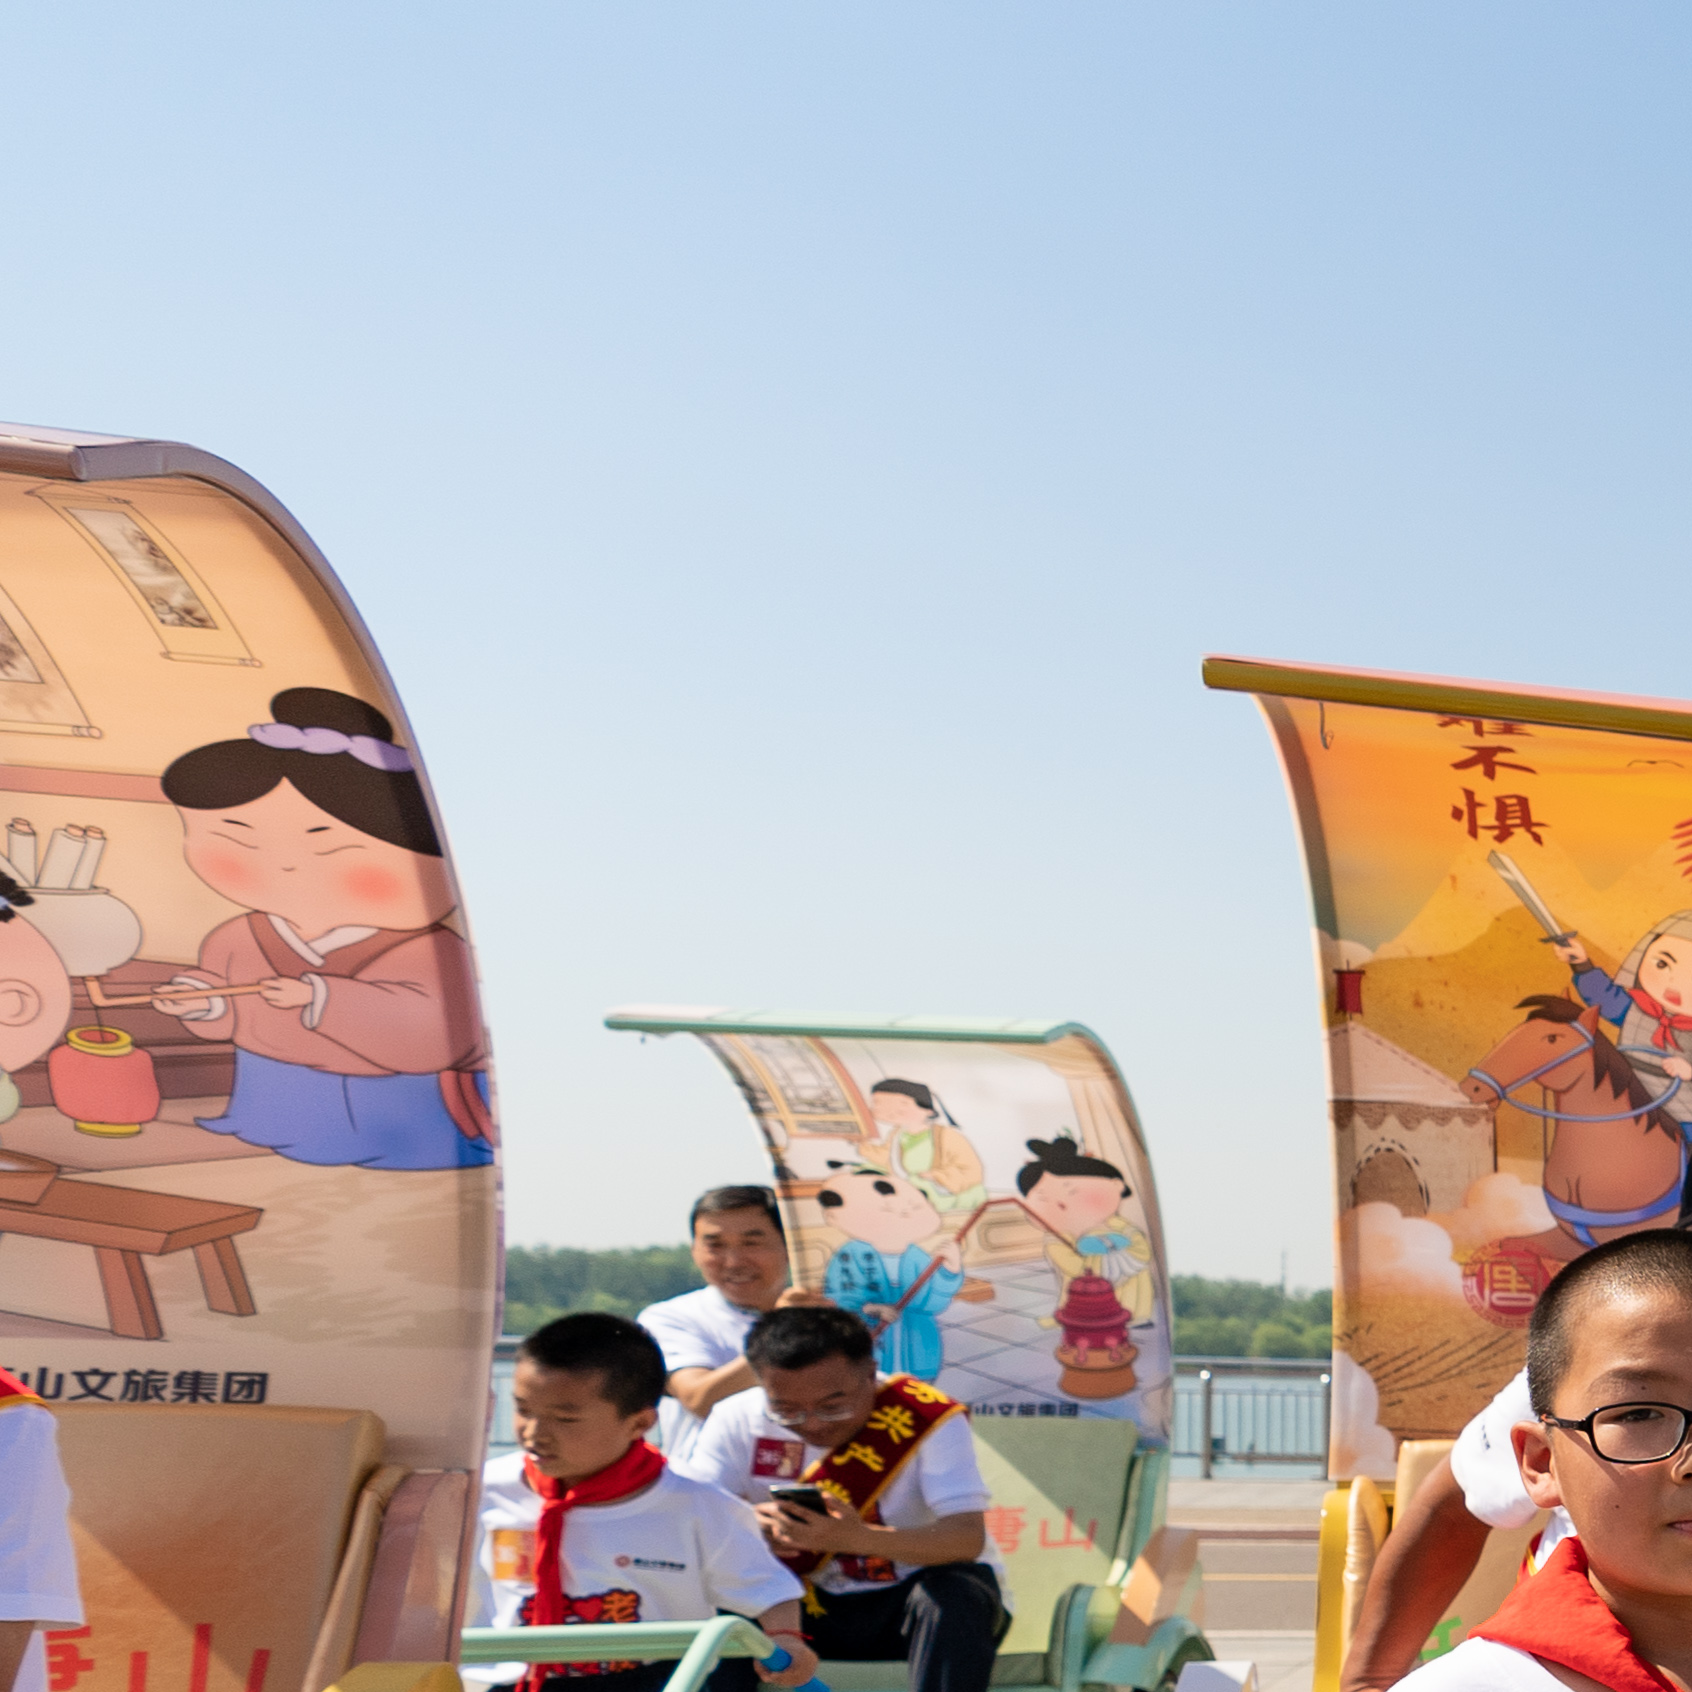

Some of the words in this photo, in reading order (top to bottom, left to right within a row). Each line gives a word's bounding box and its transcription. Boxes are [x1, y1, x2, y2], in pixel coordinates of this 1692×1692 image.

[0, 1366, 268, 1404] 山文旅集团
